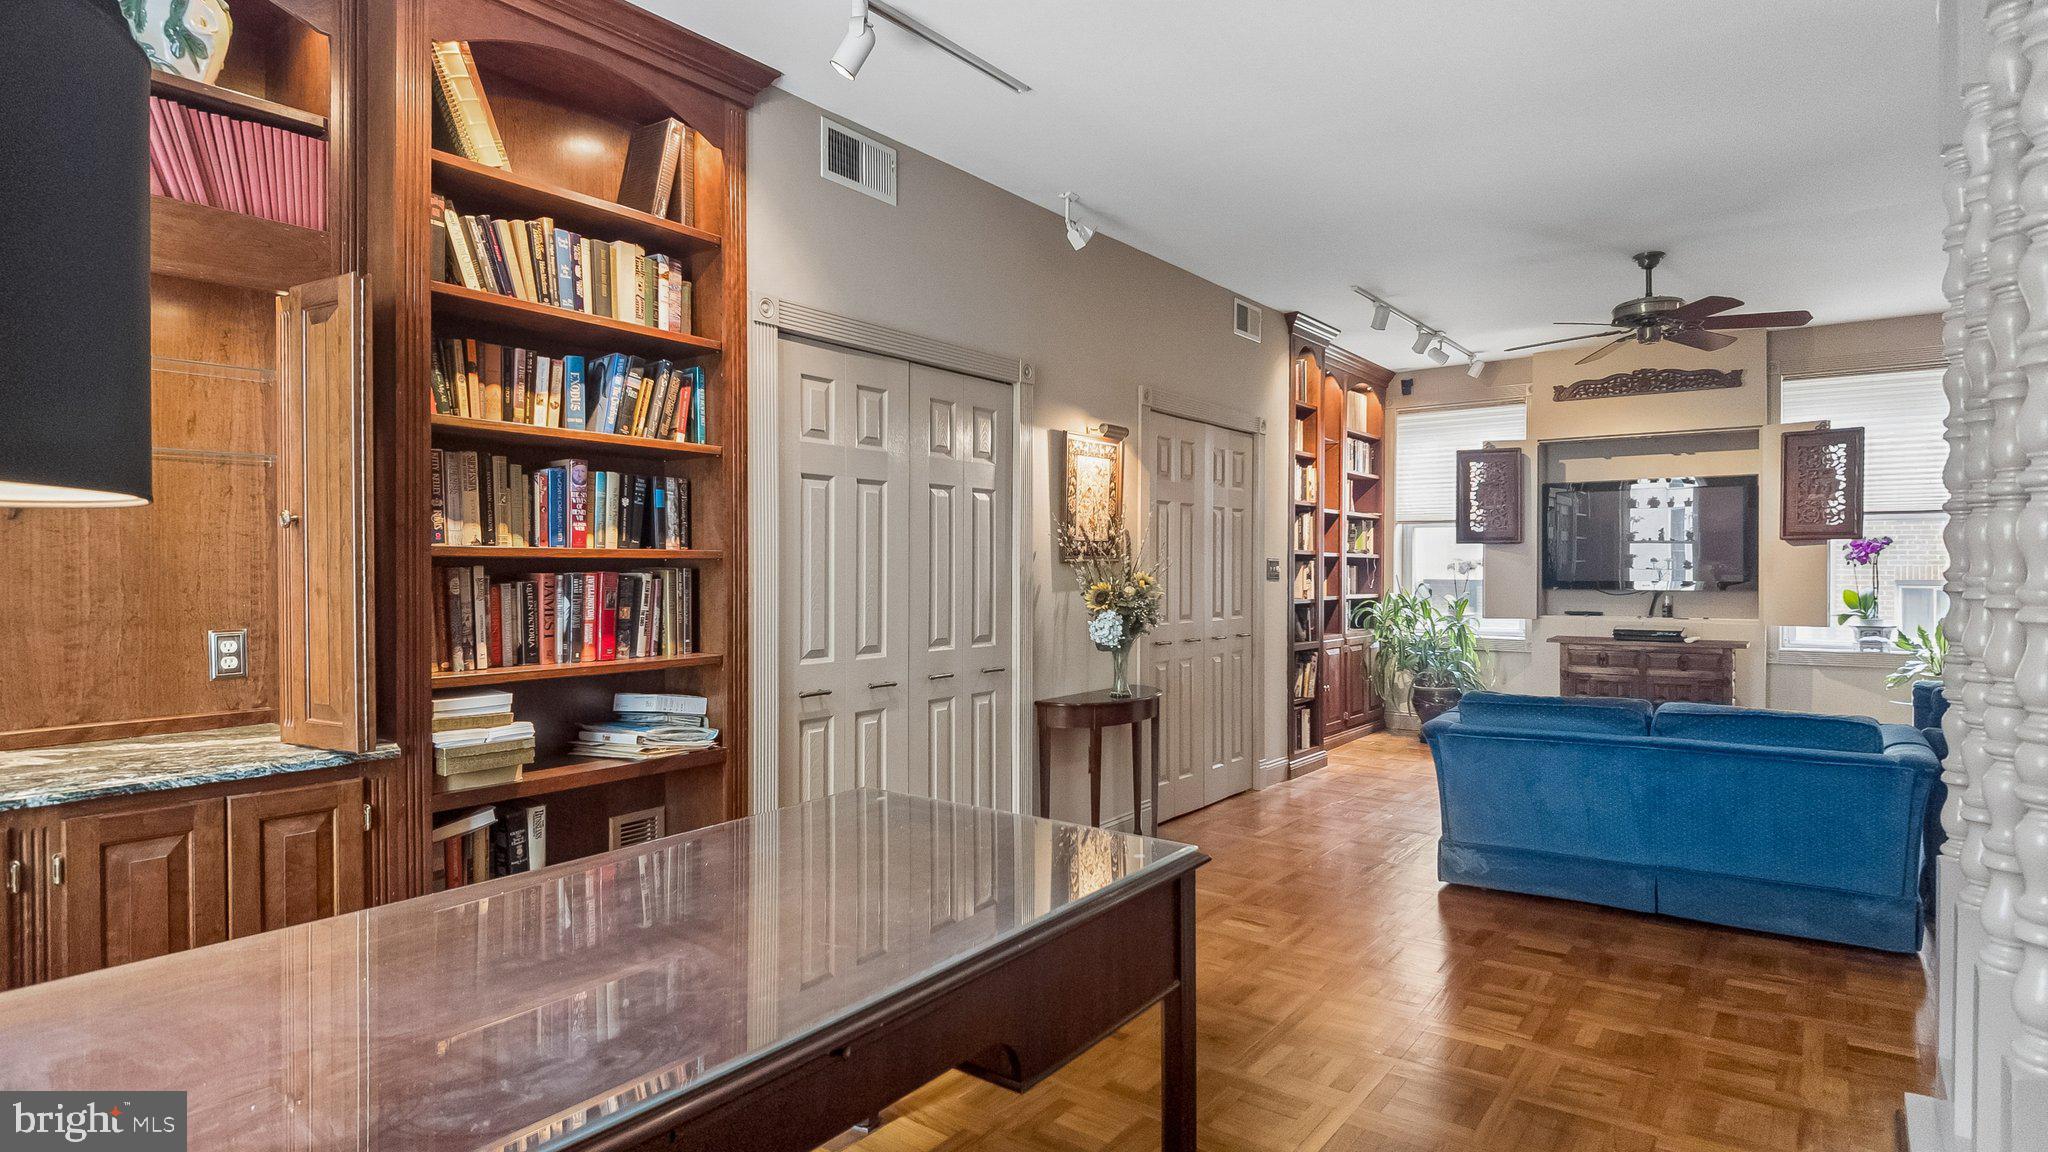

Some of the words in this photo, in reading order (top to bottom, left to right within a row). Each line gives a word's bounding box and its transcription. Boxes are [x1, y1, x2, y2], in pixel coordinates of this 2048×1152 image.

[569, 372, 581, 411] EXODUS
[432, 473, 441, 495] KELLEY
[543, 582, 555, 631] JAMES
[527, 611, 535, 648] VICTORIA
